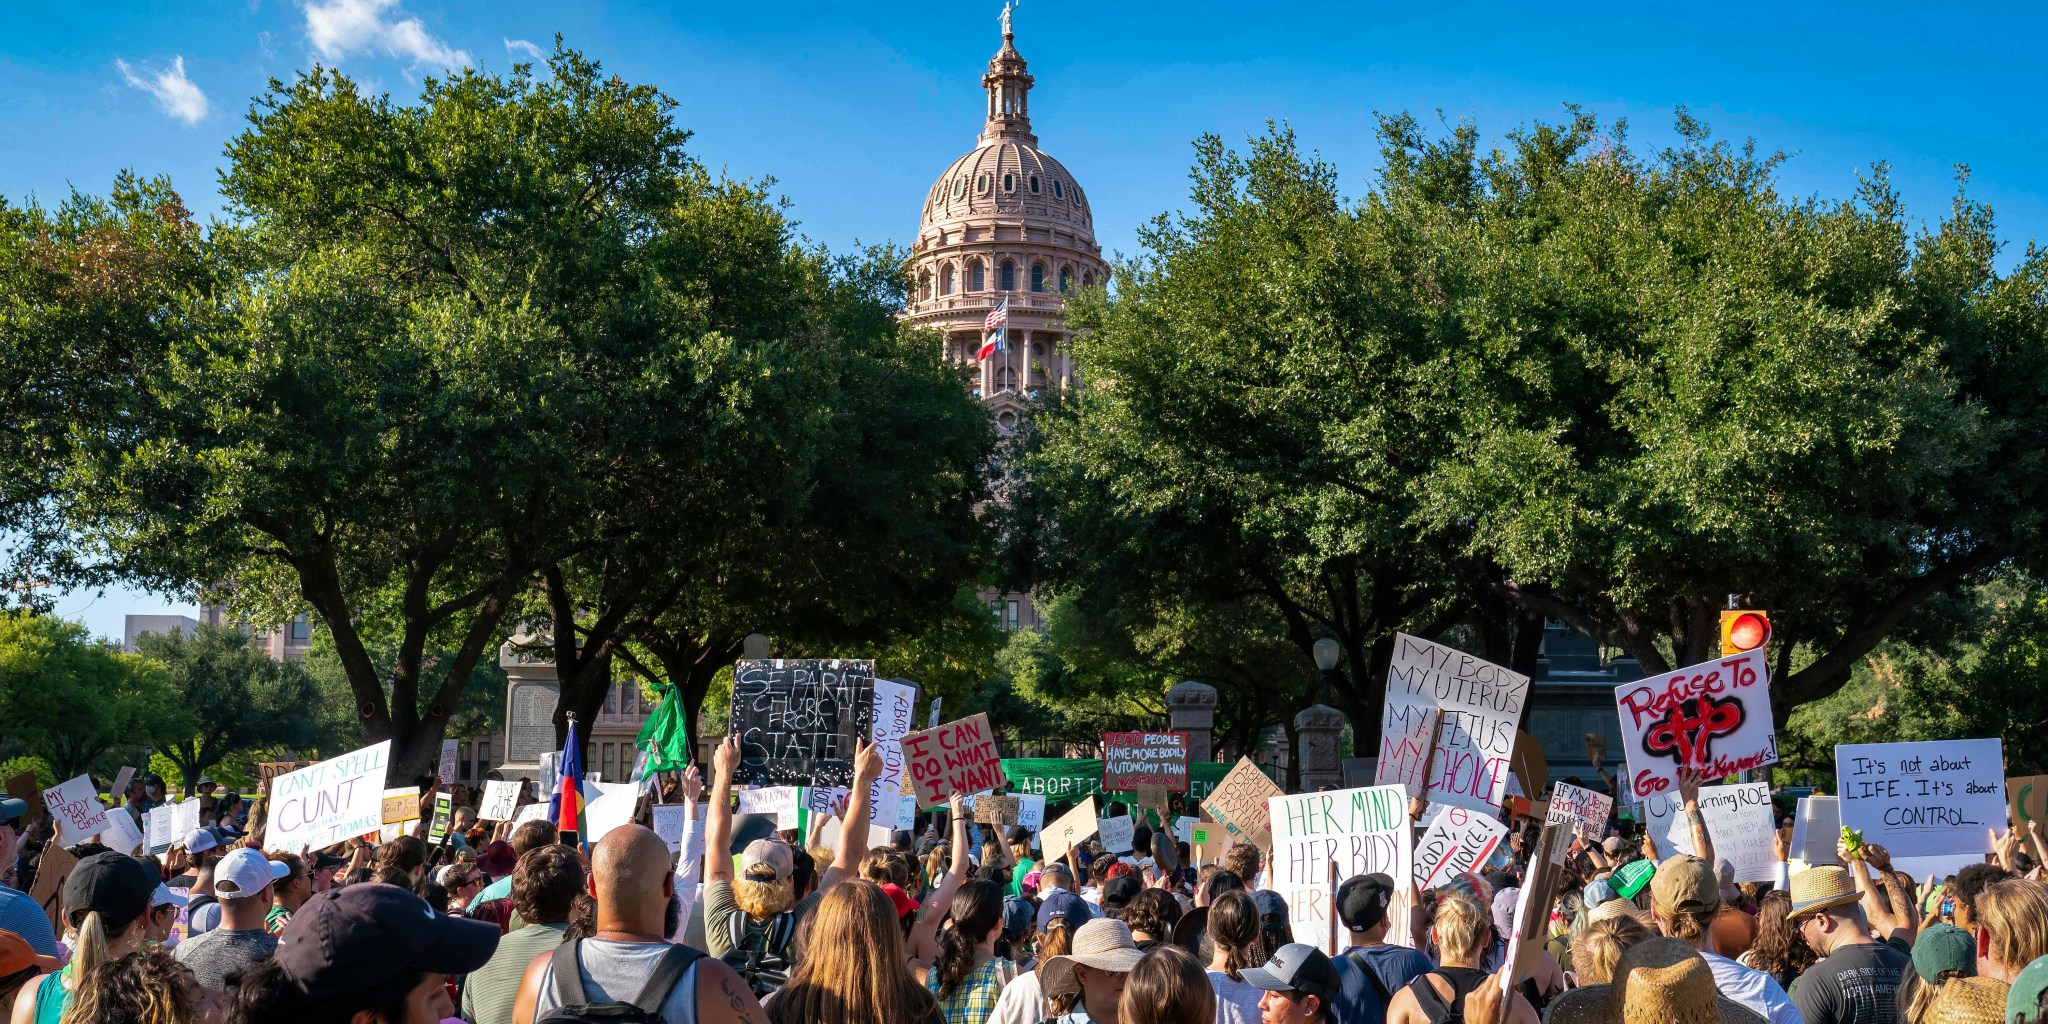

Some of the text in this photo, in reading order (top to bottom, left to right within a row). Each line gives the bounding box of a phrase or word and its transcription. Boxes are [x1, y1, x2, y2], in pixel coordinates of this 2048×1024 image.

[1401, 638, 1528, 694] MY BODY
[740, 668, 875, 706] SEPARATE
[1388, 664, 1521, 714] MY UTERUS
[1620, 657, 1756, 731] Refuse To
[753, 695, 852, 721] CHURCH
[769, 711, 828, 731] FROM
[884, 694, 910, 787] ABORTION
[905, 720, 981, 759] I CAN
[1106, 733, 1180, 747] DEAD PEOPLE
[1388, 702, 1513, 754] MY FETUS
[743, 727, 848, 767] STATE
[912, 741, 992, 781] DO WHAT
[1106, 746, 1187, 761] HAVE MORE BODILY
[279, 766, 328, 797] CAN'T
[333, 750, 386, 780] SPELL
[925, 778, 946, 802] I
[948, 757, 1000, 794] WANT
[1105, 760, 1186, 775] AUTONOMY THAN
[1240, 763, 1280, 798] ABBOTT
[1379, 736, 1511, 808] MY CHOICE
[1852, 754, 1972, 776] It's not about
[45, 787, 65, 806] MY
[1021, 776, 1123, 796] ABORTI
[1118, 775, 1180, 789] WOMEN!
[1232, 771, 1262, 803] CRUZ
[1555, 782, 1569, 797] If
[1569, 787, 1588, 806] My
[1634, 769, 1670, 797] Go
[1914, 779, 1954, 796] It's
[1965, 778, 1998, 795] about
[60, 796, 90, 818] BODY
[71, 808, 87, 825] MY
[278, 775, 364, 833] CUNT
[656, 808, 682, 824] MY
[811, 787, 833, 814] HOICE
[1215, 791, 1260, 836] PAXTON
[1224, 782, 1266, 824] CORNYN
[1285, 788, 1403, 837] HER MIND
[1552, 797, 1575, 813] Shot
[1649, 785, 1772, 818] Oveurning ROE
[77, 811, 108, 830] CHOICE
[328, 814, 377, 841] THOMAS
[1206, 802, 1228, 825] HAVE
[1225, 821, 1243, 837] GOT
[1738, 822, 1760, 836] THEM
[1289, 831, 1399, 885] HER BODY
[1413, 825, 1457, 884] BODY,
[1444, 818, 1494, 881] CHOICE!
[1741, 837, 1771, 850] MAKES
[1287, 888, 1325, 924] HER
[1837, 968, 1860, 981] DARK
[1860, 967, 1878, 977] SIDE
[1843, 985, 1872, 999] NORTH
